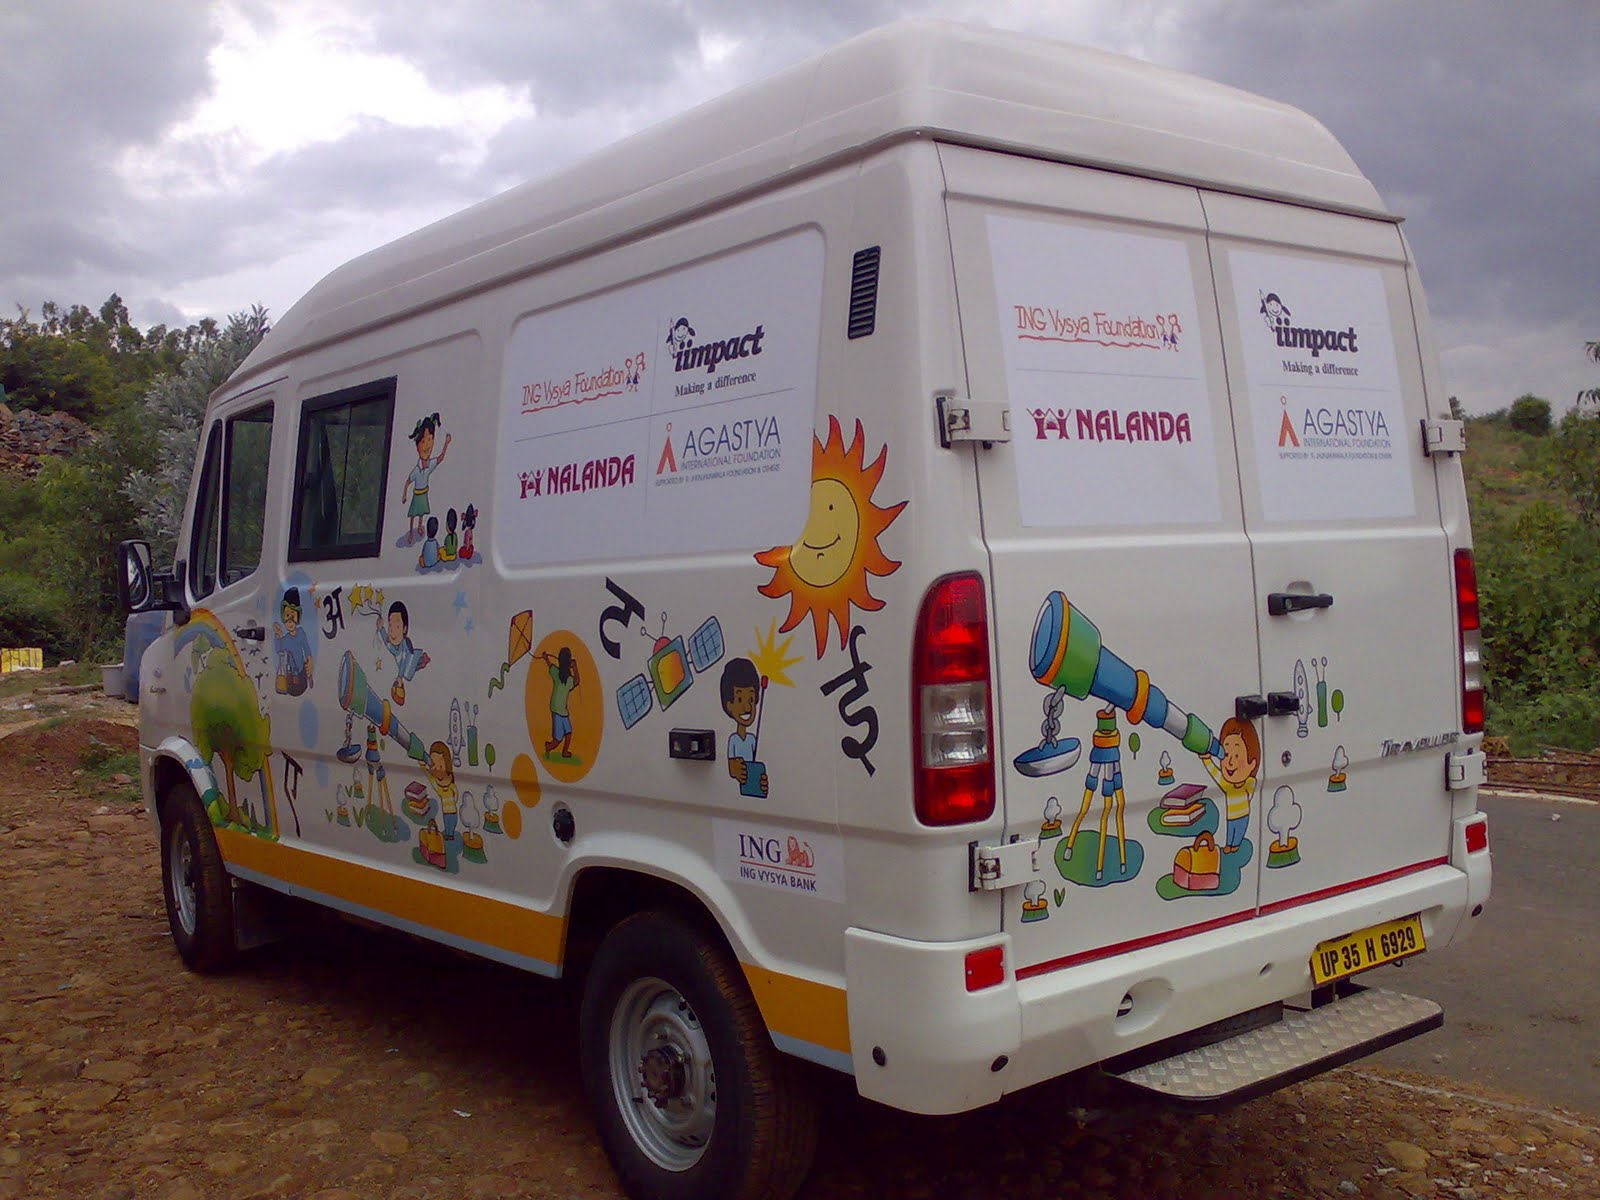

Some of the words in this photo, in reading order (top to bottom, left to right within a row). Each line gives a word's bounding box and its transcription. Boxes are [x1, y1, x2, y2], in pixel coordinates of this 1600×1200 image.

[1014, 304, 1047, 331] ING
[1048, 308, 1091, 337] Vysya
[1093, 311, 1160, 340] Foundation
[1275, 316, 1359, 358] iimpact
[674, 324, 765, 374] iimpact
[522, 383, 542, 406] ING
[543, 379, 572, 405] Vysya
[574, 365, 625, 395] Foundation
[675, 382, 705, 397] Making
[707, 381, 713, 391] a
[714, 372, 757, 390] difference
[1281, 360, 1313, 376] Making
[1315, 366, 1321, 374] a
[1322, 362, 1359, 377] difference
[682, 416, 781, 459] AGASTYA
[1075, 408, 1192, 445] NALANDA
[1303, 407, 1390, 437] AGASTYA
[680, 456, 732, 471] INTERNATIONAL
[733, 448, 782, 464] FOUNDATION
[1303, 438, 1351, 448] INTERNATIONAL
[1352, 438, 1392, 448] FOUNDATION
[547, 453, 636, 496] NALANDA
[321, 585, 346, 640] अ
[738, 833, 781, 864] ING
[740, 866, 756, 880] ING
[757, 869, 788, 887] VYSYA
[790, 876, 817, 892] BANK
[1320, 950, 1339, 977] UP
[1343, 942, 1361, 971] 35
[1365, 938, 1377, 963] H
[1380, 926, 1416, 957] 6929
